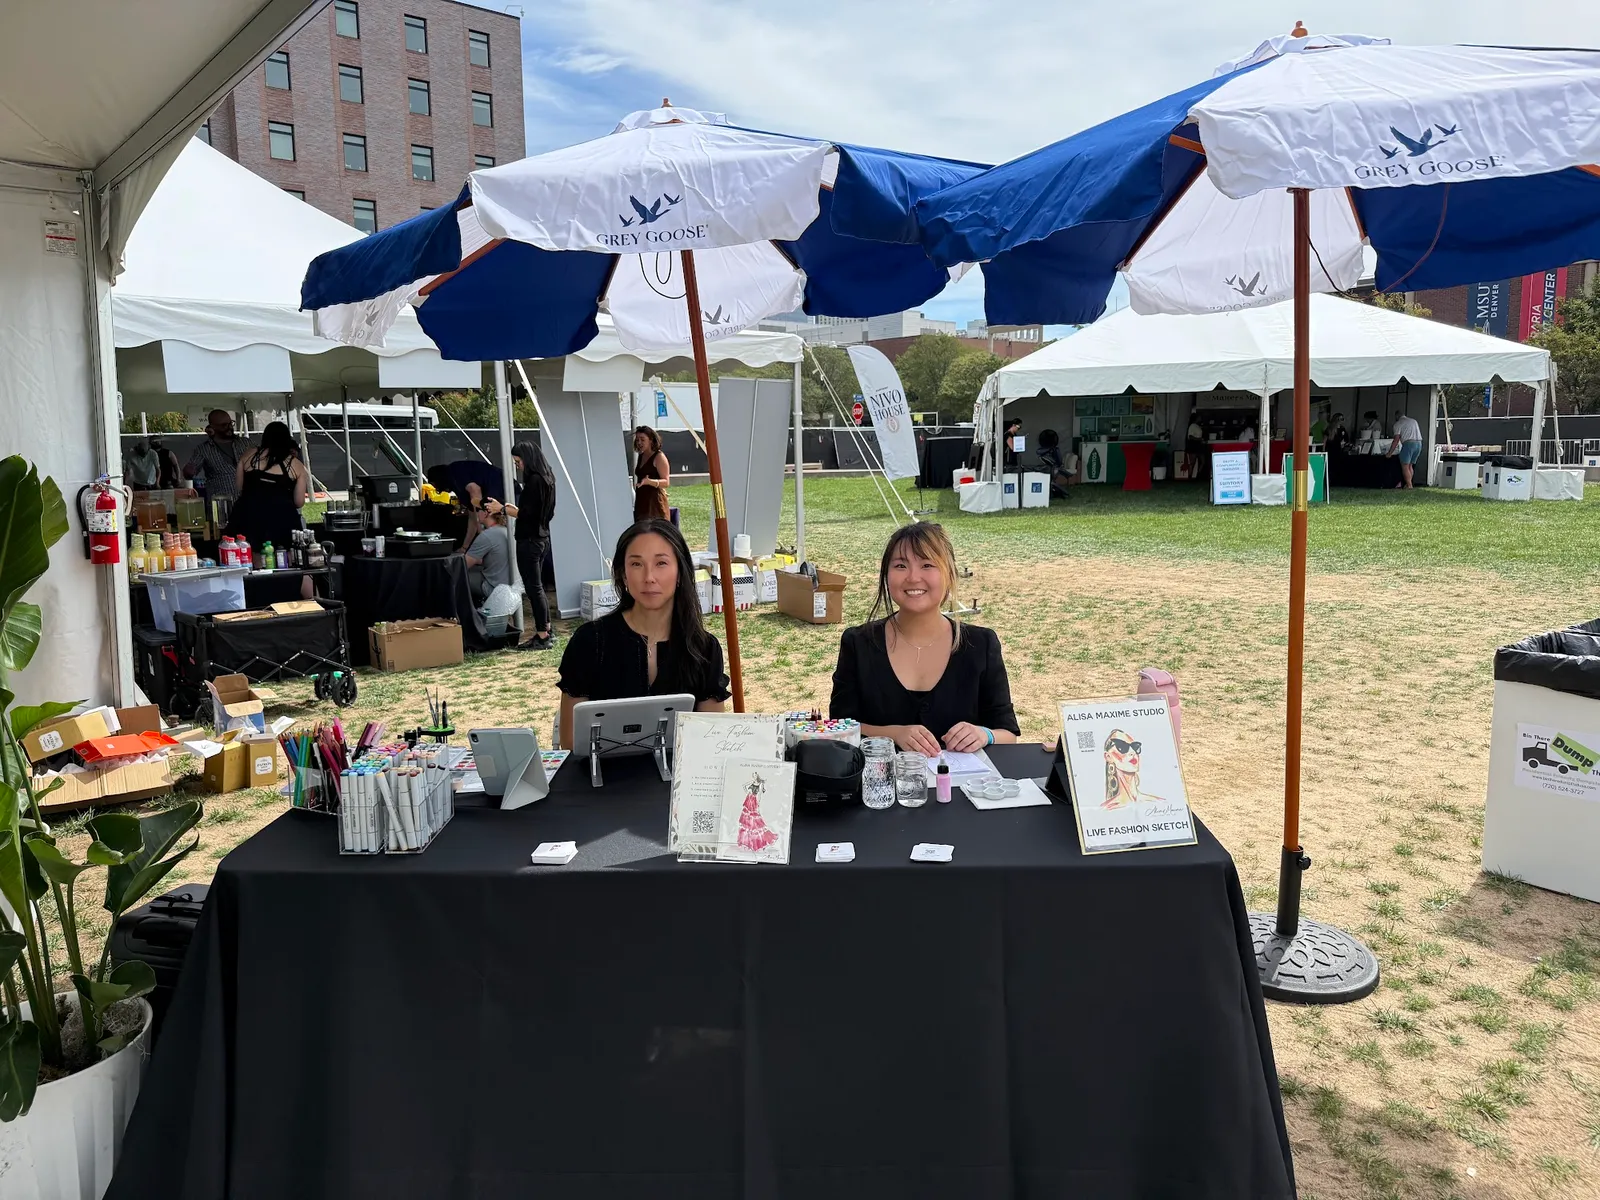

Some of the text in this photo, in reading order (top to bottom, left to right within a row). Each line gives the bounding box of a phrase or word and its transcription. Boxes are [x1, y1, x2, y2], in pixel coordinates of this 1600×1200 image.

[1354, 155, 1504, 180] GREY GOOSE
[596, 224, 706, 246] GREY GOOSE
[1476, 284, 1491, 319] MSU
[1490, 283, 1500, 318] DENVER
[1543, 273, 1556, 321] CENTER
[869, 388, 902, 410] NIVO
[873, 404, 906, 421] HOUSE
[1067, 707, 1165, 721] ALISA MAXIME STUDIO
[1533, 734, 1551, 742] There
[1552, 736, 1594, 768] Dump
[1086, 821, 1189, 837] LIVE FASHION SKETCH
